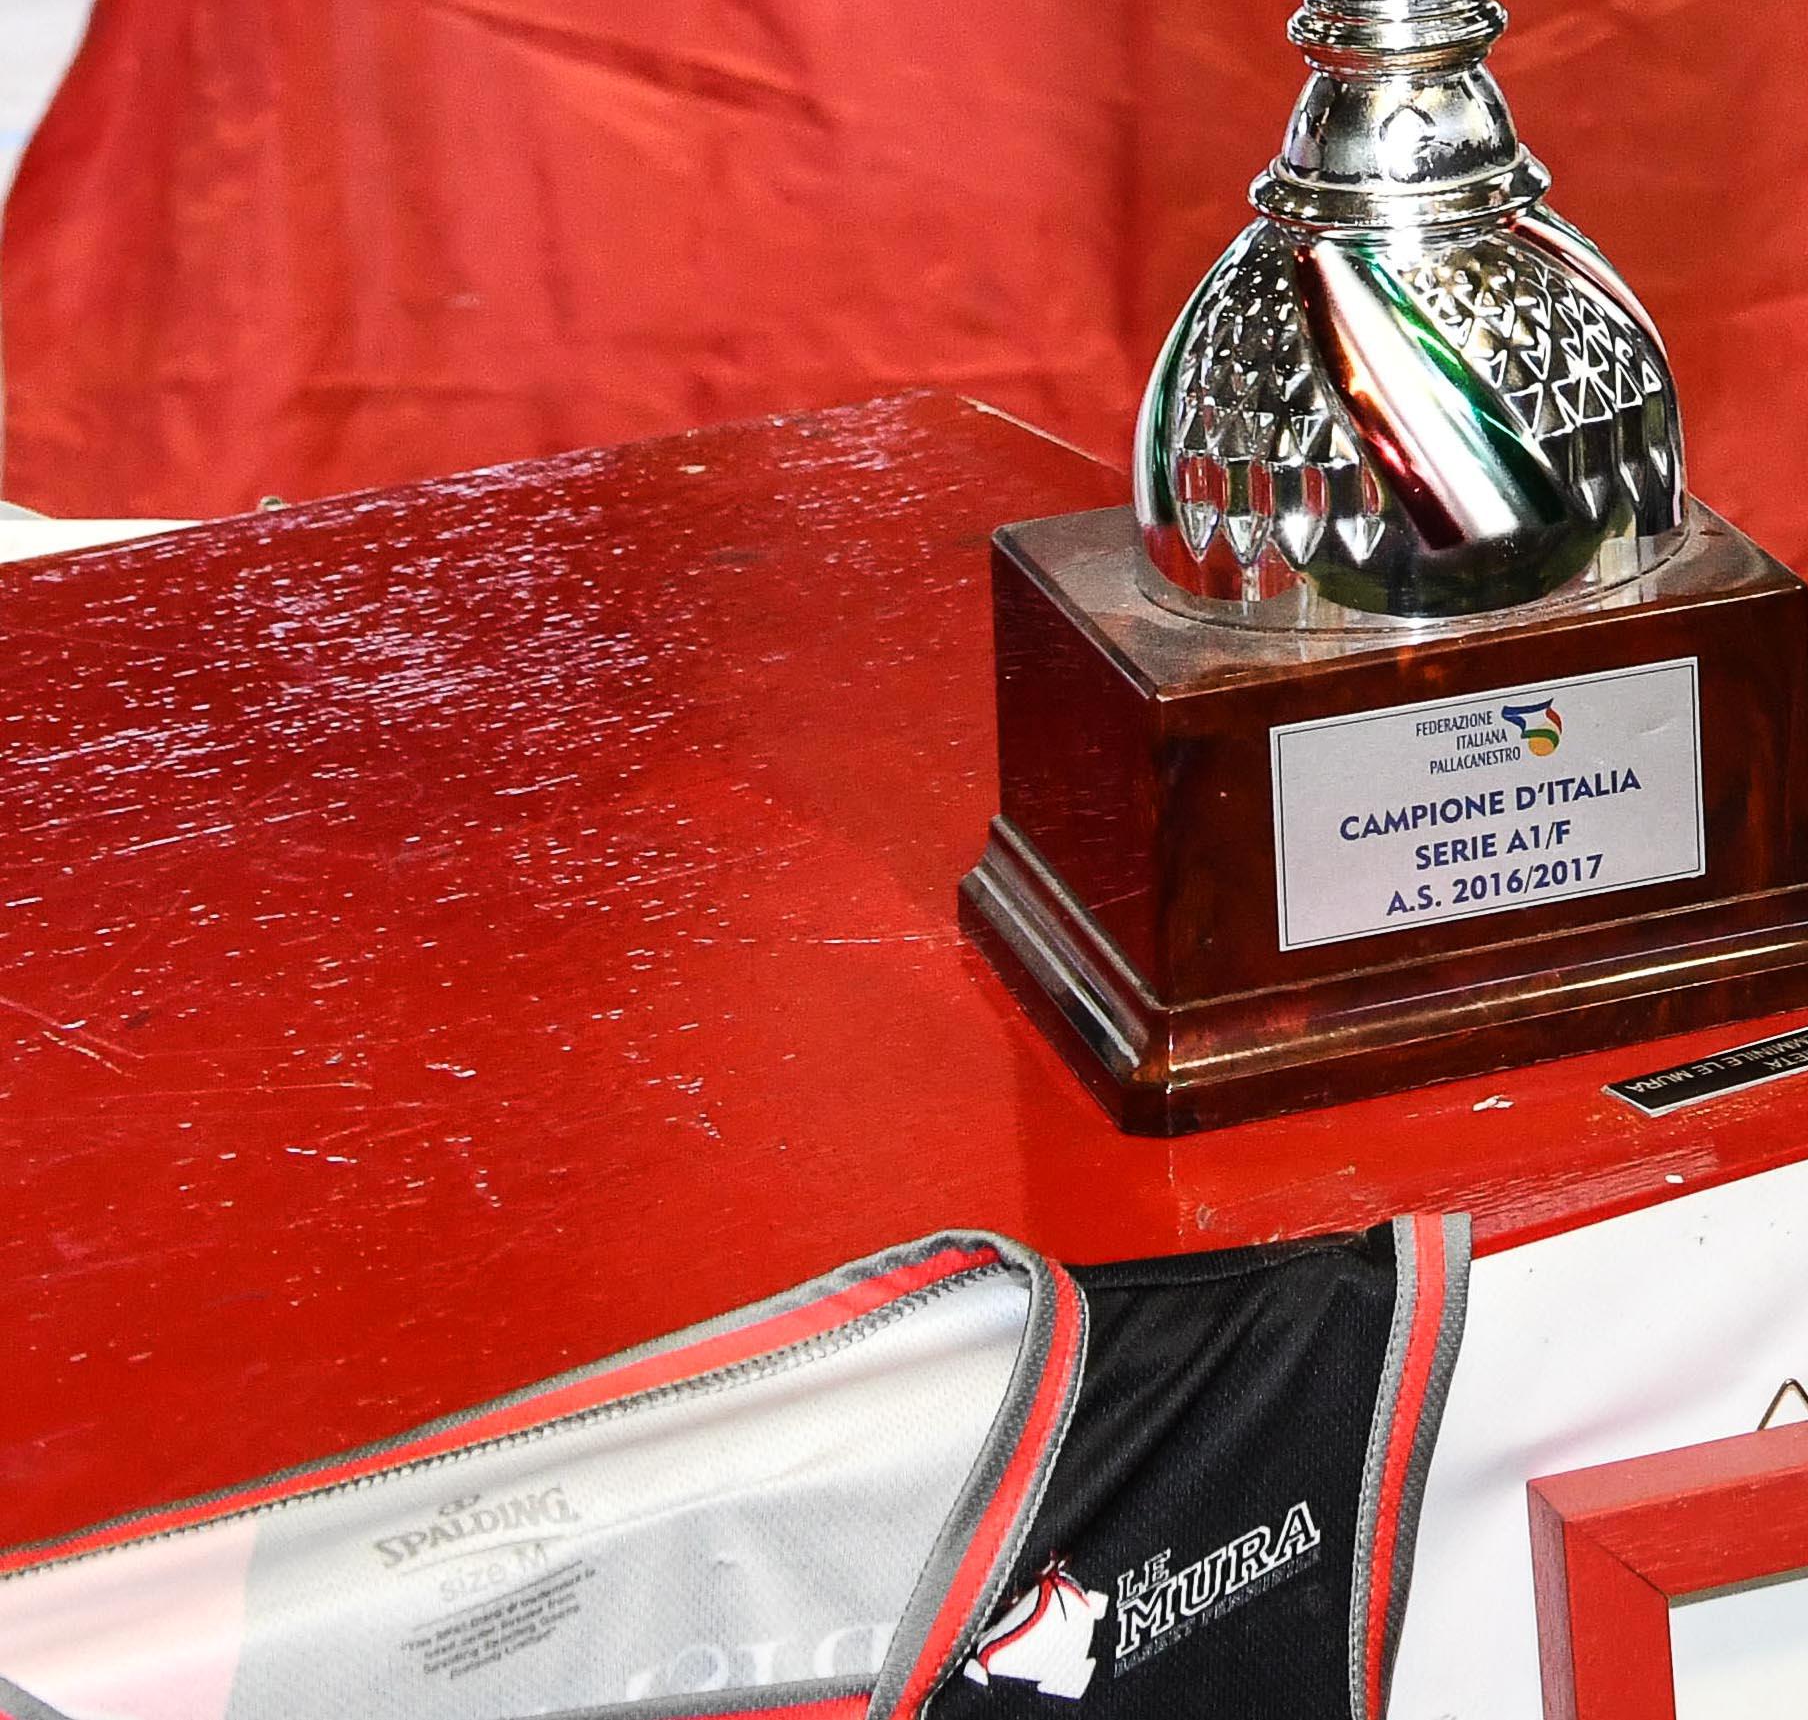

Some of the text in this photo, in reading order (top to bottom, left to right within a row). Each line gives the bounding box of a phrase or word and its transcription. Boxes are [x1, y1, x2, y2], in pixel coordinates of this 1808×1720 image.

[1415, 710, 1493, 738] FEDERAZIONE
[1455, 728, 1508, 750] ITALIANA
[1429, 746, 1521, 775] PALLACANESTRO
[1339, 767, 1642, 842] CAMPIONE D'ITALIA
[1415, 819, 1572, 871] SERIE A1/F
[1385, 853, 1604, 916] A.S. 2016/2017
[1625, 1068, 1692, 1094] MURA
[1691, 1061, 1725, 1077] LE
[372, 1485, 579, 1570] SPALDING
[514, 1541, 549, 1577] M
[1115, 1500, 1321, 1660] MURA
[1116, 1547, 1172, 1609] LE
